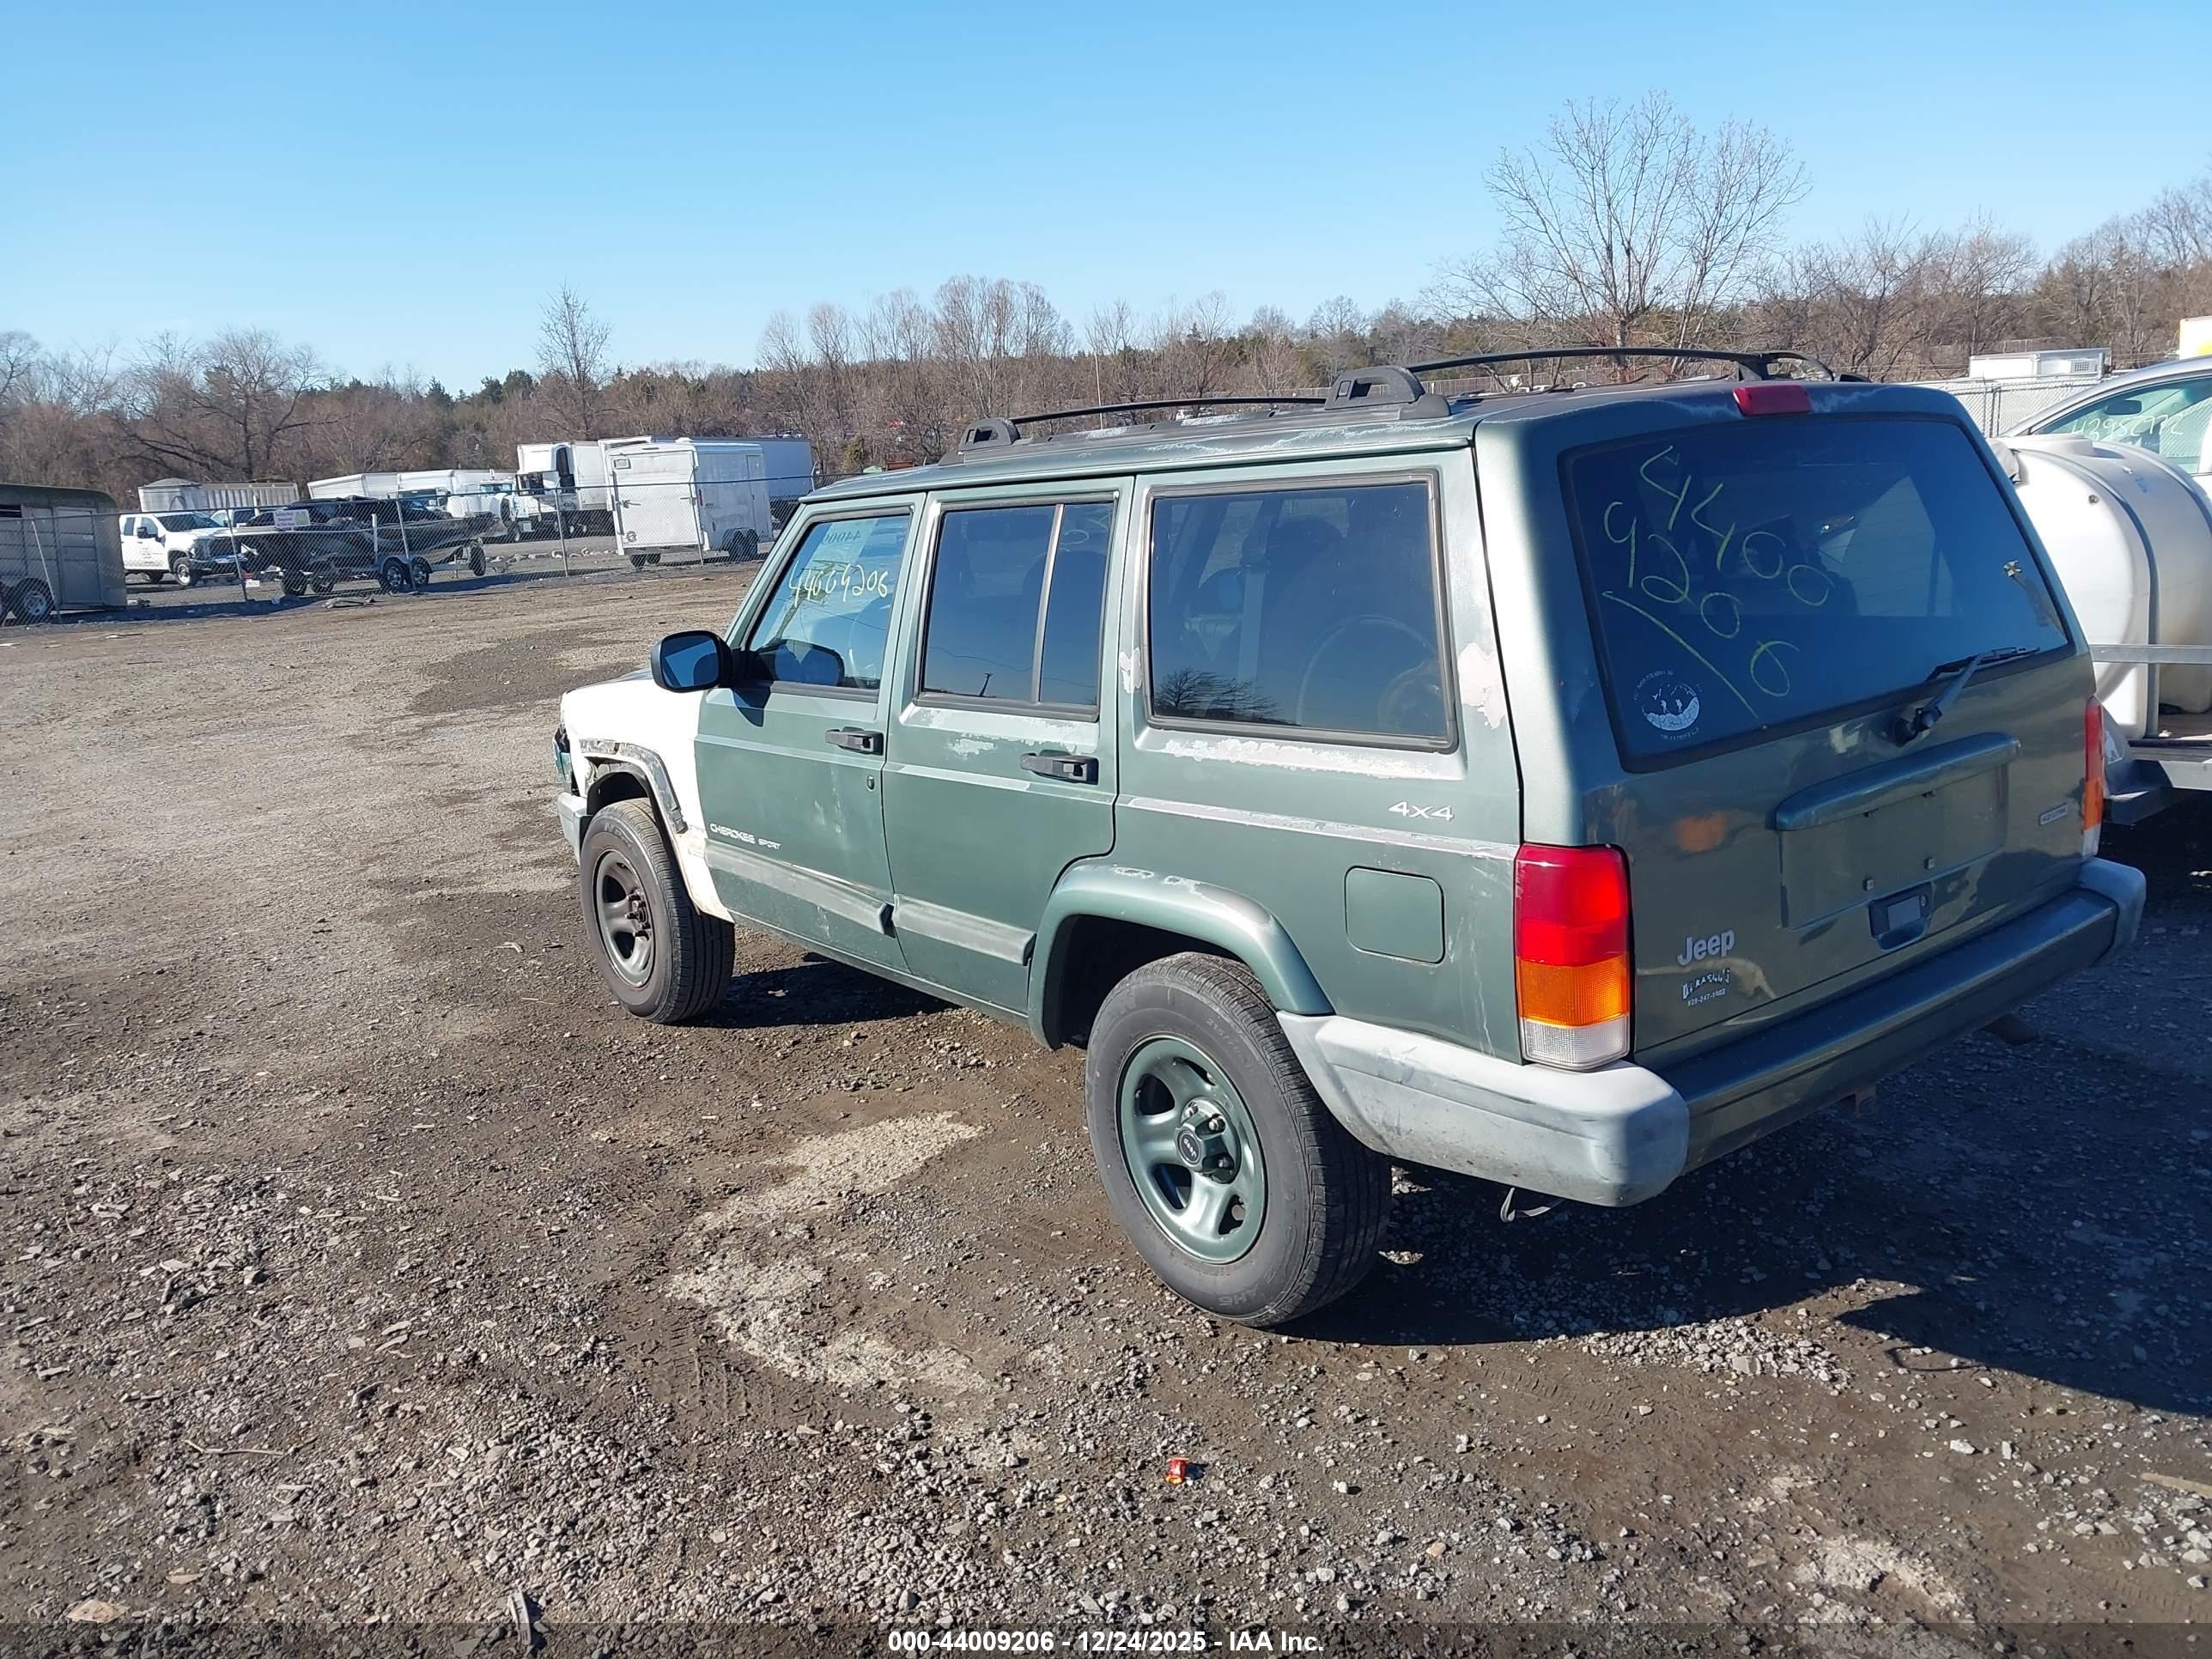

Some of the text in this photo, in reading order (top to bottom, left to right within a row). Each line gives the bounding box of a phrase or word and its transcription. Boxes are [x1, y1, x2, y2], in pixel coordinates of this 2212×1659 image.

[788, 560, 889, 608] 44009206
[709, 823, 782, 850] CHEROKEE SPORT
[1676, 928, 1735, 967] Jeep
